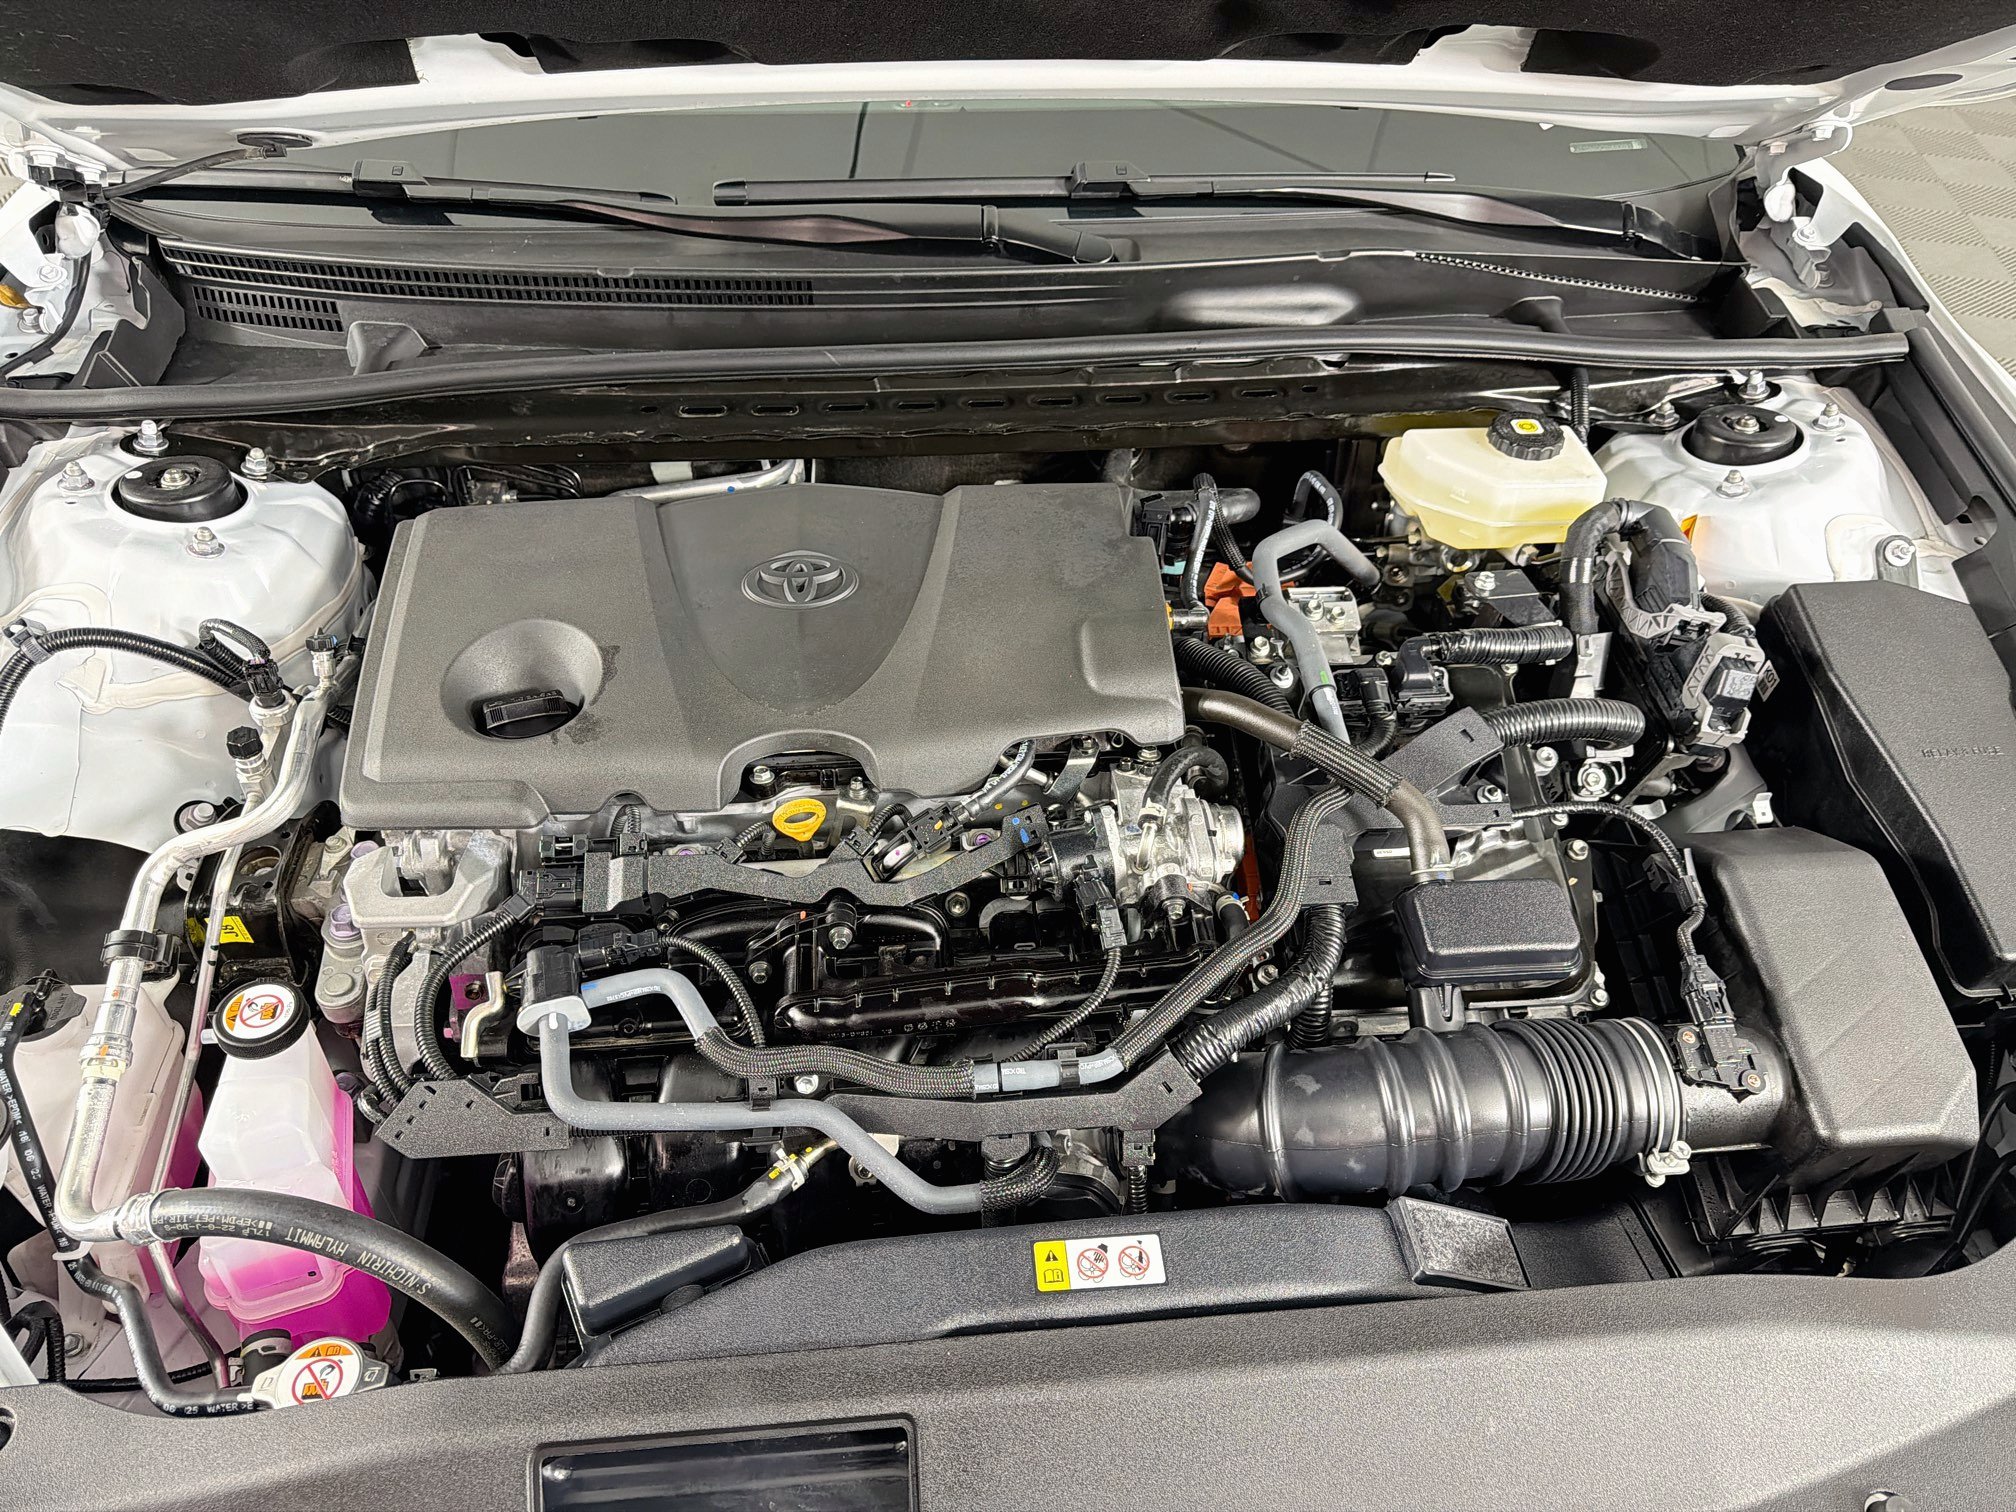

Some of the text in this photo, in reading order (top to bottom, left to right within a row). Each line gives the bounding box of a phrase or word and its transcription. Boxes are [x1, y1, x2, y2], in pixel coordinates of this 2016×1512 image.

[1764, 665, 1777, 688] K01
[284, 1225, 350, 1257] HYLAMMIT
[206, 1403, 239, 1414] WATER
